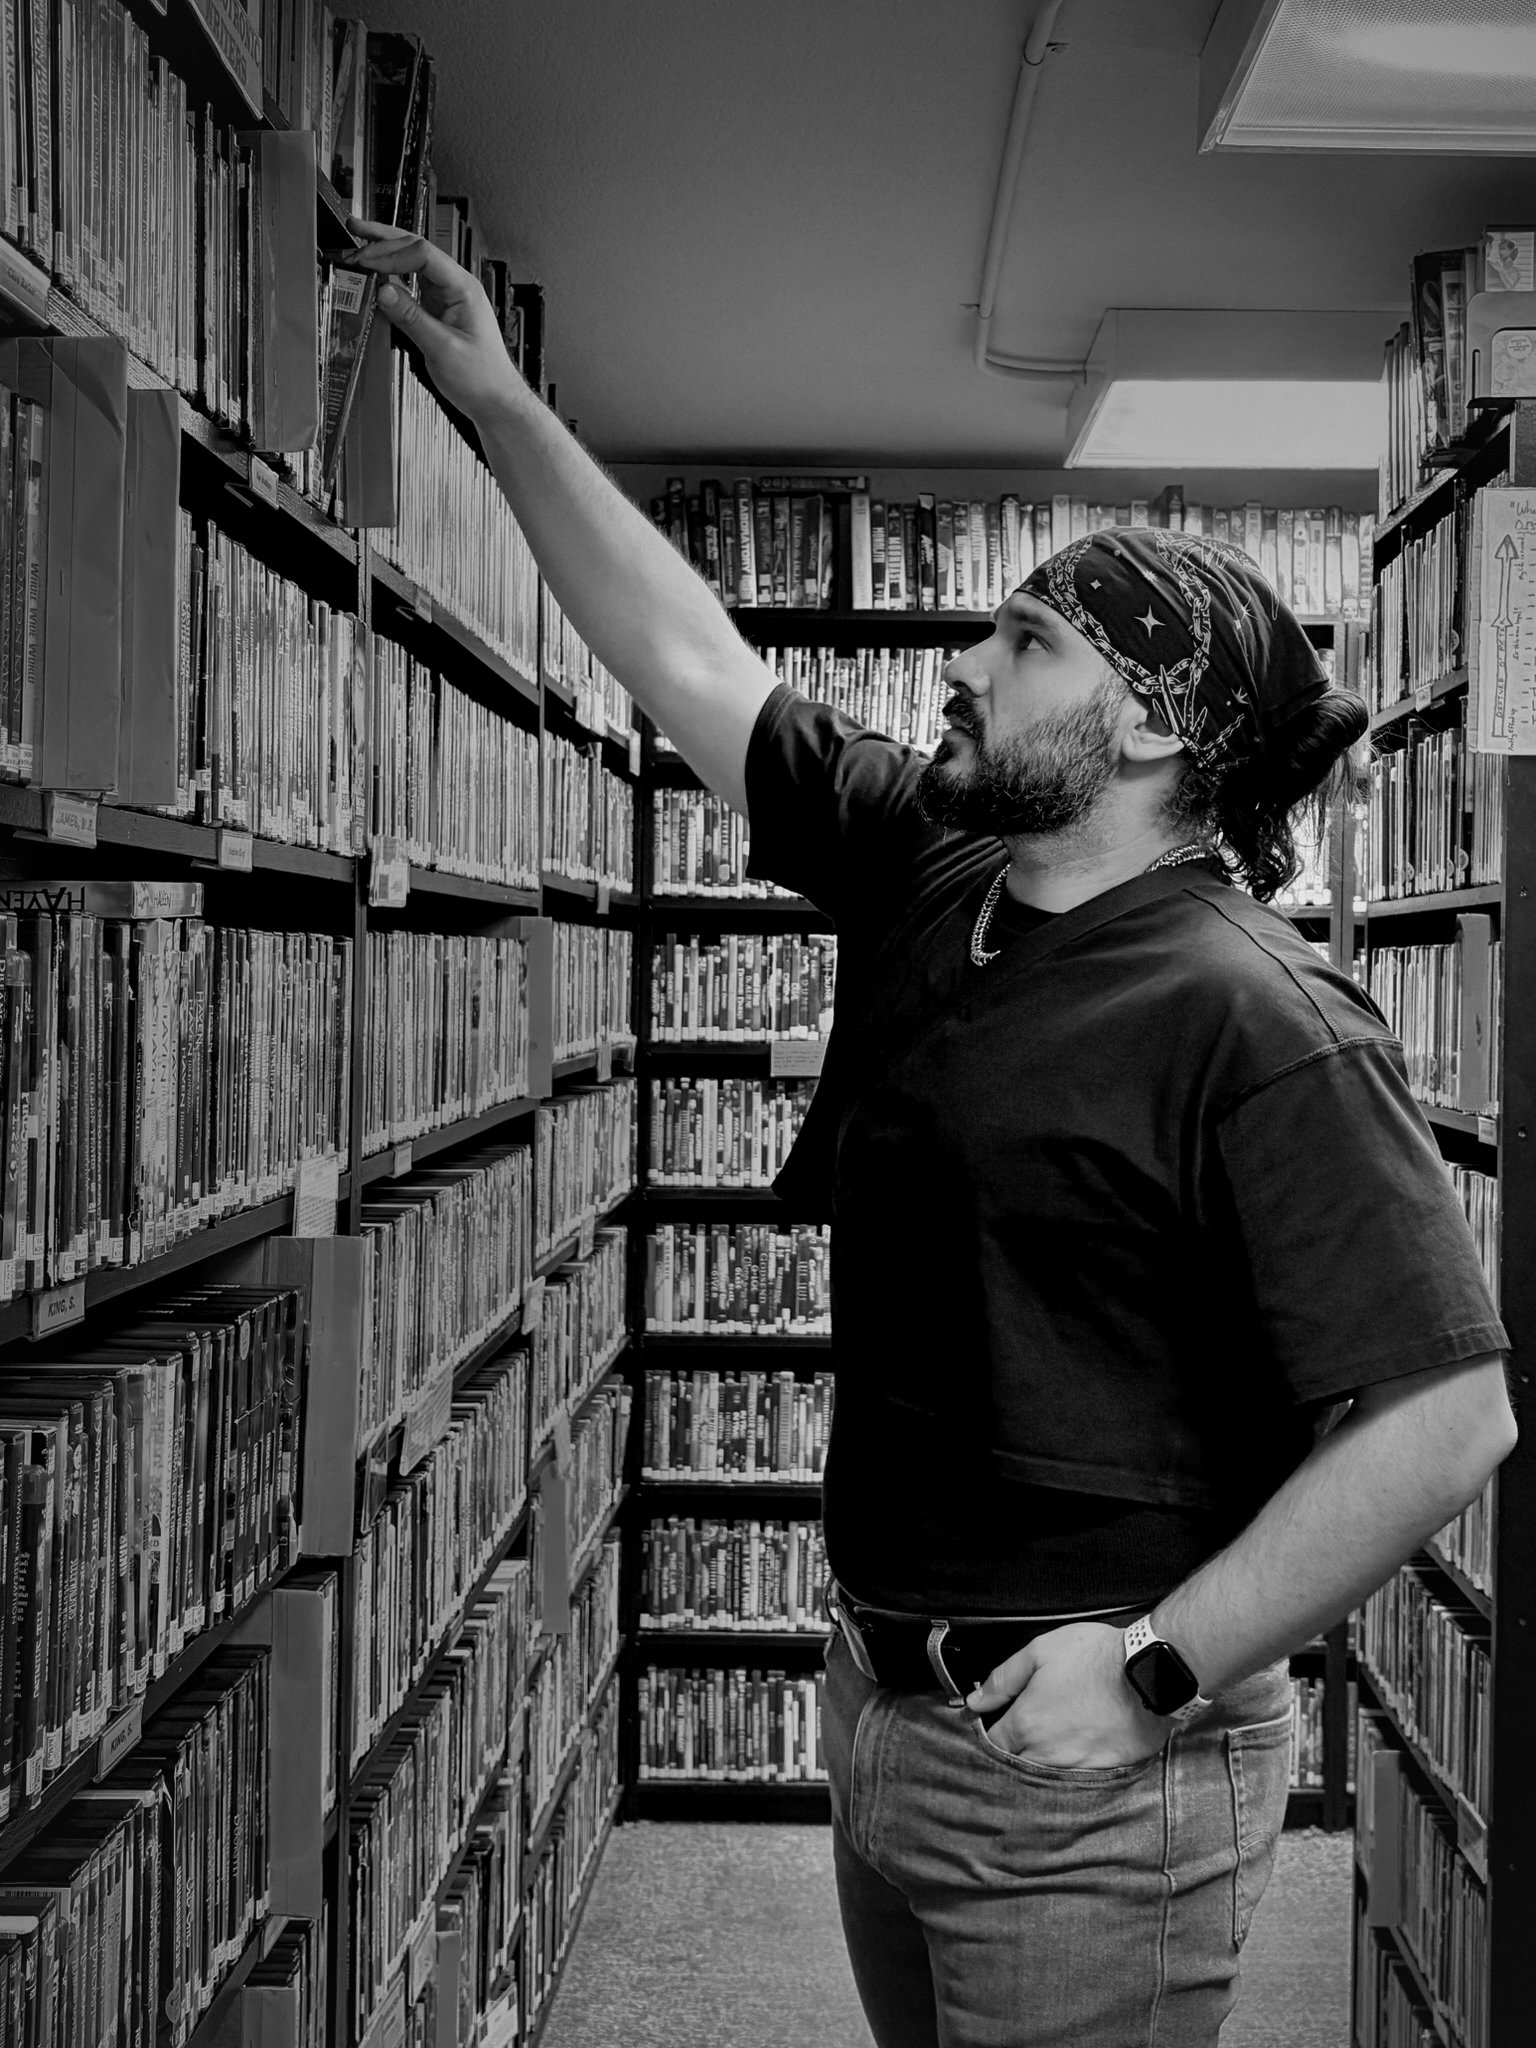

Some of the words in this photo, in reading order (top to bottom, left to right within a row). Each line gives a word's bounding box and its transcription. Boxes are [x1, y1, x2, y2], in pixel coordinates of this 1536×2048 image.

[324, 65, 332, 153] KNIGHTS
[15, 515, 25, 644] SOLOMON
[13, 654, 22, 714] KANE
[161, 1005, 169, 1082] HAVEN
[195, 991, 204, 1046] HAVEN
[150, 1024, 158, 1095] HAVEN
[179, 1047, 187, 1108] HAVEN
[20, 1092, 30, 1206] FIRESTARTER
[48, 1299, 67, 1318] KING,
[69, 1296, 76, 1309] S.
[239, 1451, 247, 1490] UNDER
[251, 1442, 259, 1480] UNDER
[264, 1432, 272, 1468] UNDER
[14, 1484, 23, 1554] SHAWSHANK
[169, 1486, 177, 1539] CENTURY
[238, 1504, 246, 1537] DOME
[118, 1534, 127, 1577] STAND
[11, 1555, 20, 1625] REDEMPTION
[110, 1728, 126, 1754] KING,
